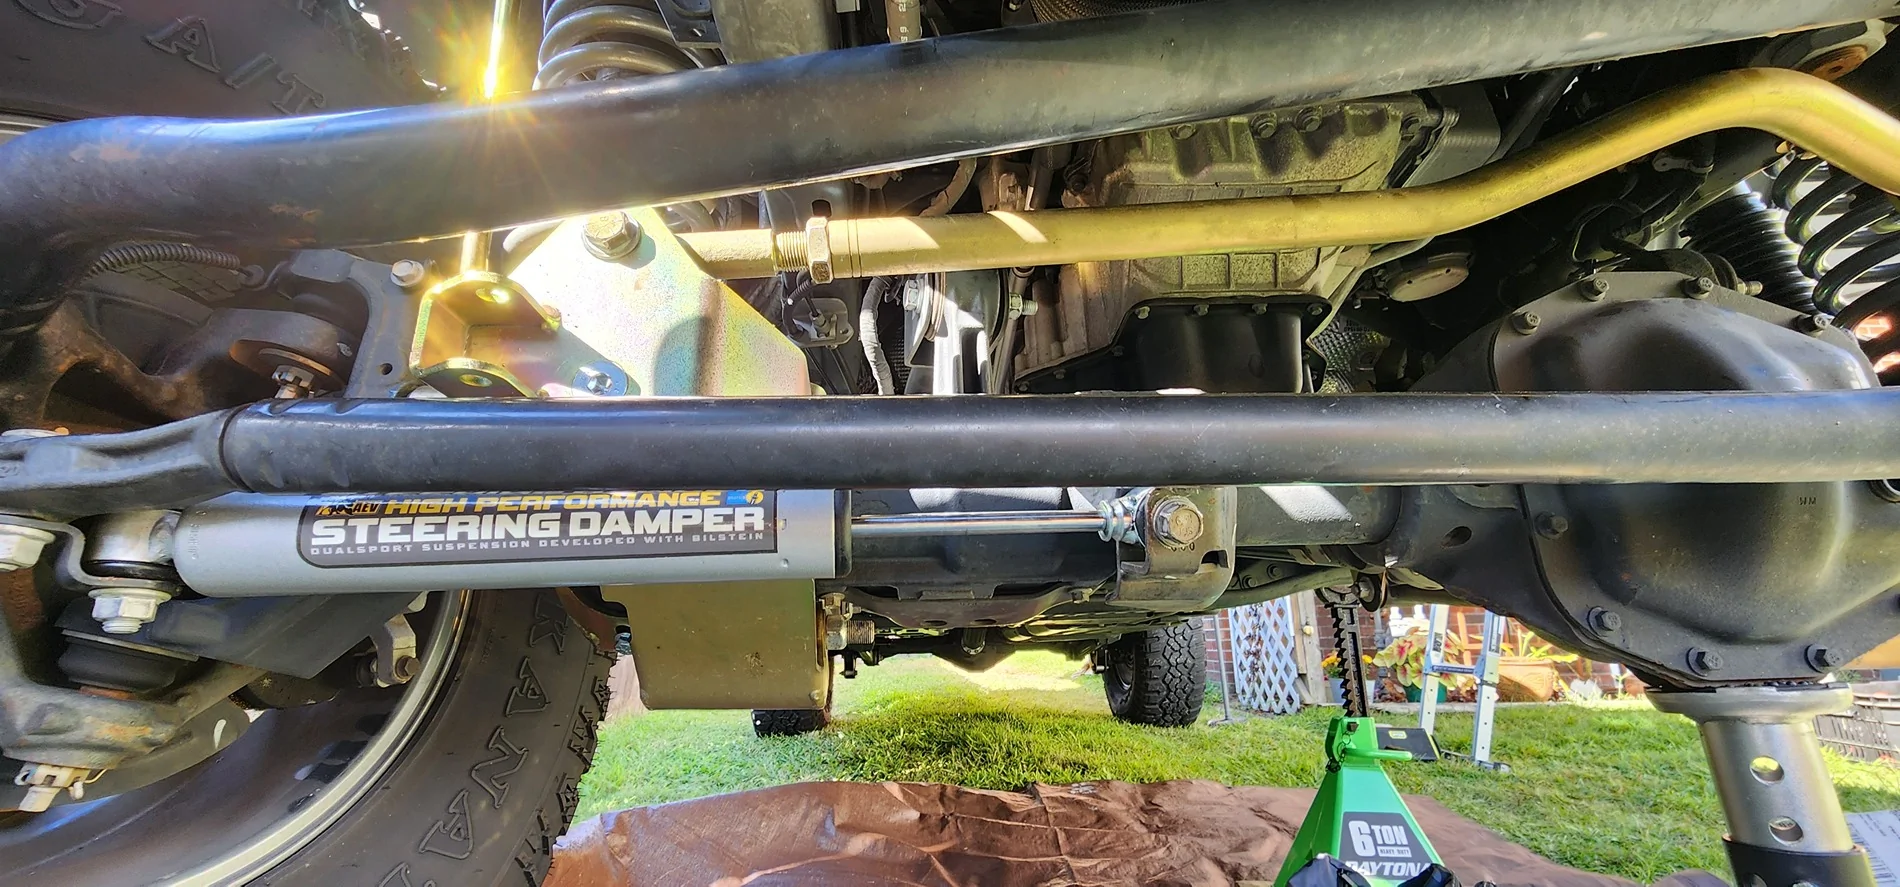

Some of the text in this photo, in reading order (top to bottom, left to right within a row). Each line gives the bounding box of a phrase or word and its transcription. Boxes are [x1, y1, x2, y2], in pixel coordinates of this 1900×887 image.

[352, 501, 380, 513] AEV
[384, 496, 467, 514] HIGH
[474, 490, 721, 514] PERFORMANCE
[311, 507, 765, 546] STEERING DAMPER
[311, 532, 763, 556] DUALSPORT SUSPENSION DEVELOPED WITH BILSTEIN
[1348, 820, 1409, 857] 6 TON
